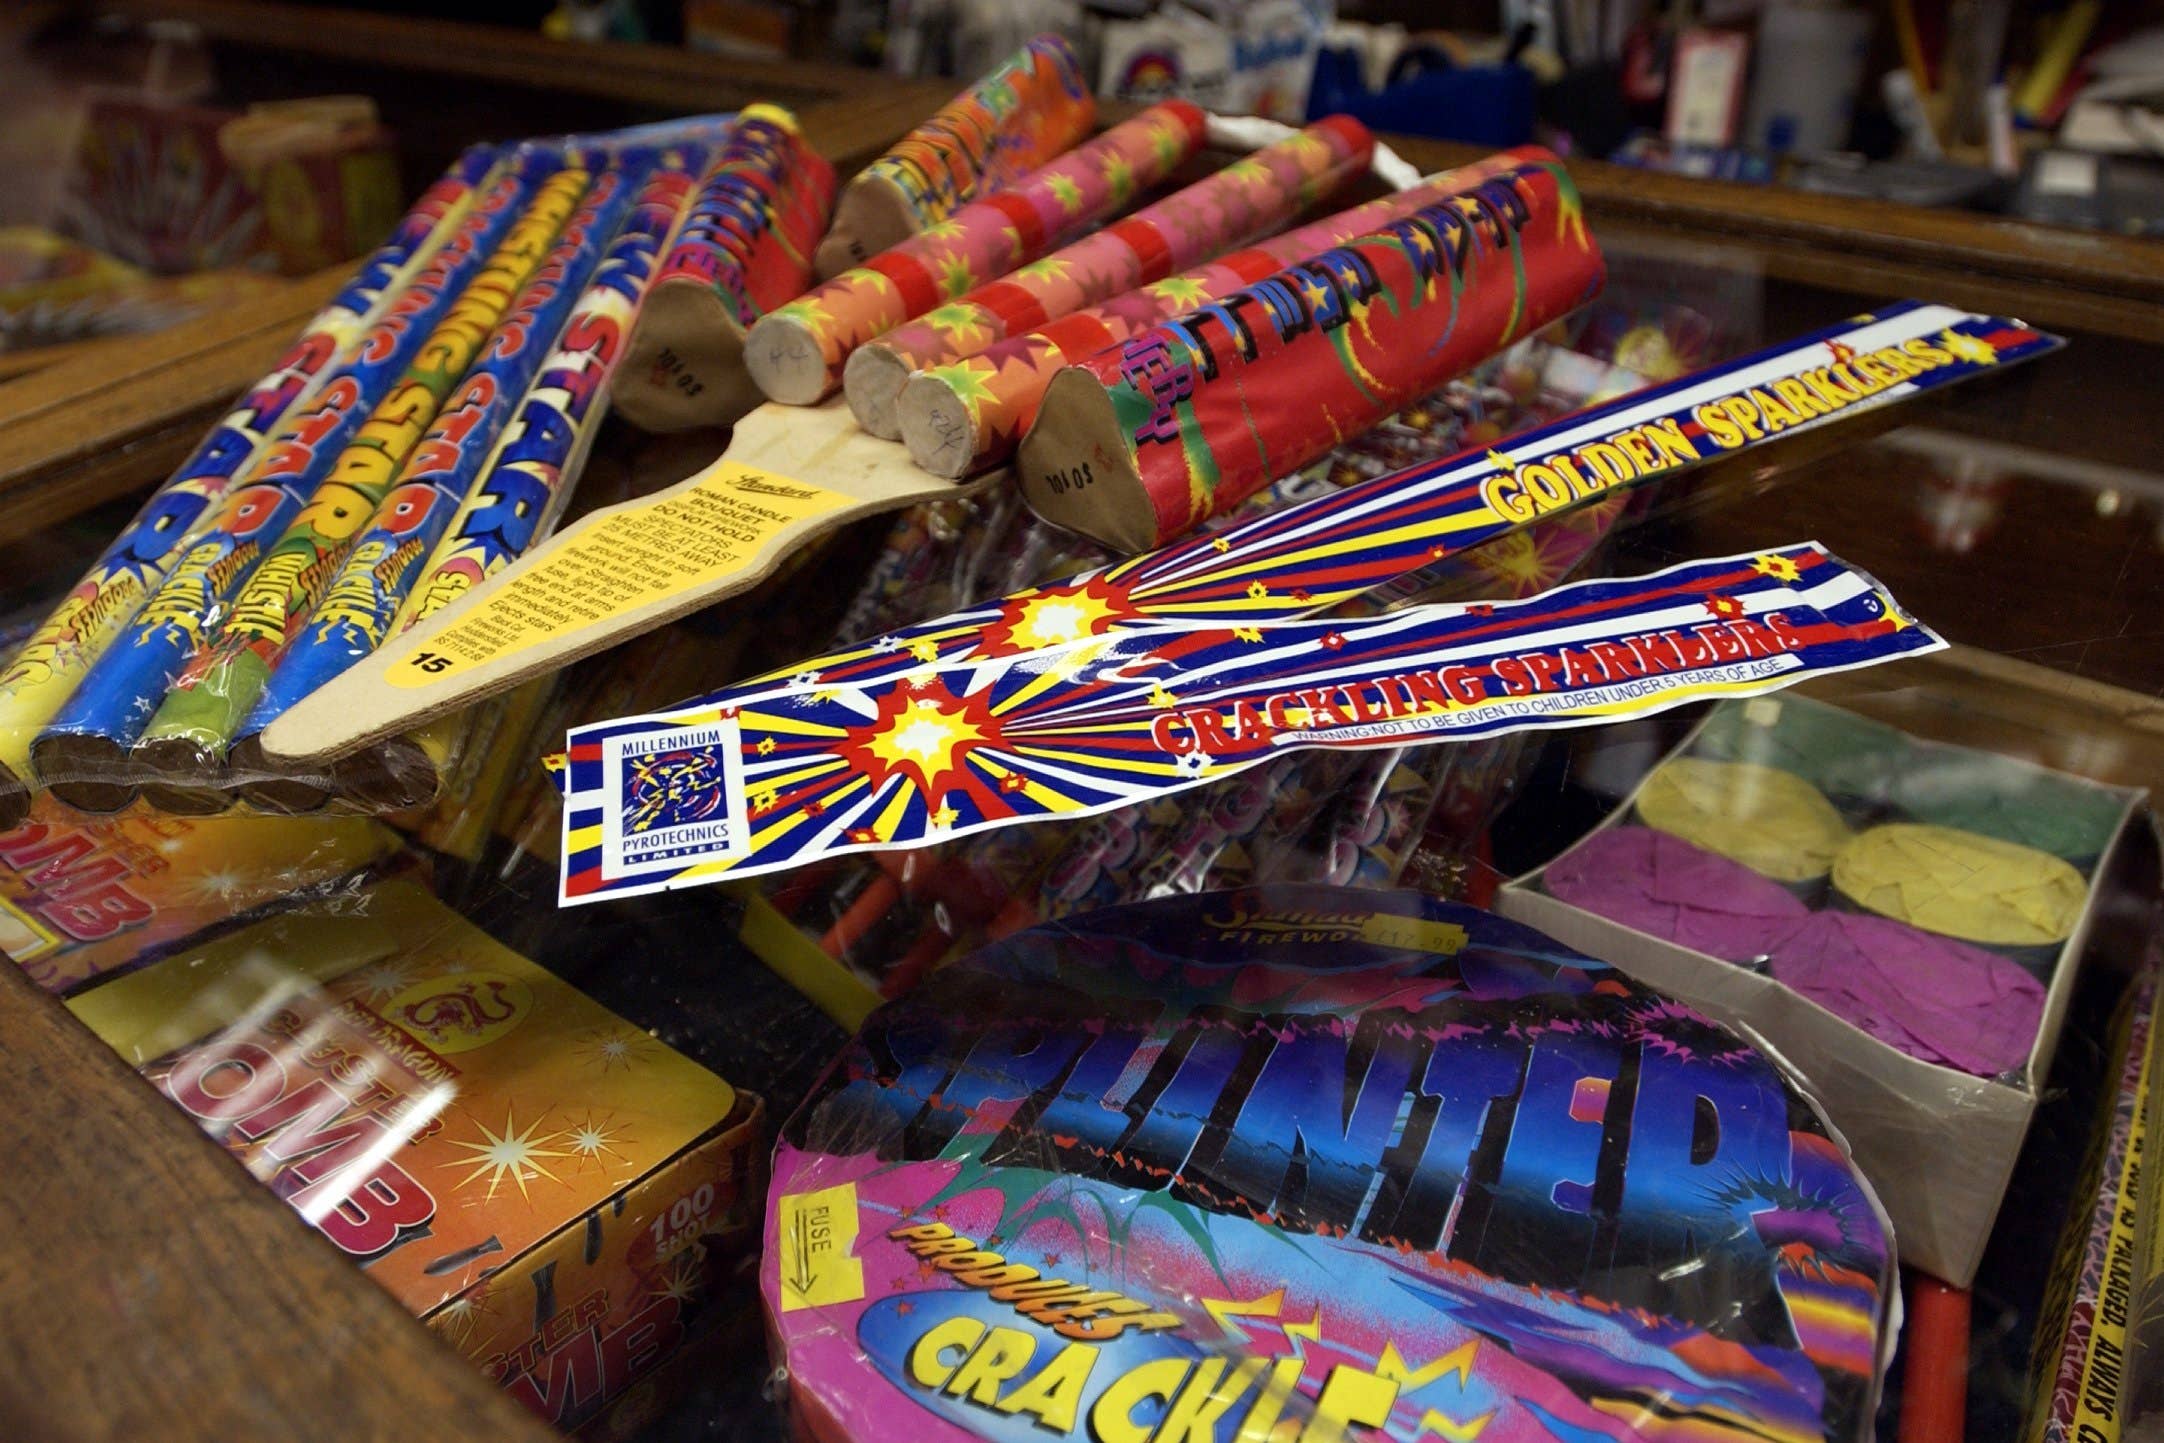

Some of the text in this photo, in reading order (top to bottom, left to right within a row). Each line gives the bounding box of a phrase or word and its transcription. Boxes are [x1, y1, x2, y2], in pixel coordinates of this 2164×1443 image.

[371, 373, 498, 536] STAR
[462, 315, 620, 557] STAR
[1480, 418, 1700, 524] GOLDEN
[1692, 338, 1955, 450] SPARKLERS
[98, 332, 337, 582] STAR
[204, 376, 361, 537] STAR
[289, 385, 440, 539] STAR
[652, 504, 756, 543] DO NOT HOLD
[690, 487, 792, 524] ROMAN CANDLE
[690, 498, 766, 526] BOUQUET
[612, 514, 741, 564] MUST BE AT LEAST
[622, 529, 680, 553] METRES
[678, 549, 723, 568] AWAY
[643, 515, 733, 549] SPECTATORS
[524, 616, 556, 632] stars
[544, 595, 571, 608] and
[410, 652, 454, 673] 15
[1151, 612, 1801, 756] CRACKLING SPARKLERS
[1411, 718, 1431, 732] TO
[1433, 712, 1457, 728] BE
[1458, 702, 1508, 725] GIVEN
[1509, 702, 1530, 716] TO
[1532, 689, 1608, 713] CHILDREN
[1606, 679, 1662, 700] UNDER
[1666, 677, 1676, 688] 5
[1676, 669, 1725, 686] YEARS
[1727, 665, 1748, 681] OF
[1752, 658, 1785, 675] AGE
[621, 729, 721, 756] MILLENNIUM
[623, 824, 729, 852] PYROTECHNICS
[628, 843, 724, 863] LIMITED
[650, 1183, 714, 1243] 100
[810, 1205, 832, 1254] FUSE
[889, 1222, 1184, 1342] PRODUCES
[2084, 1334, 2123, 1422] ALWAYS
